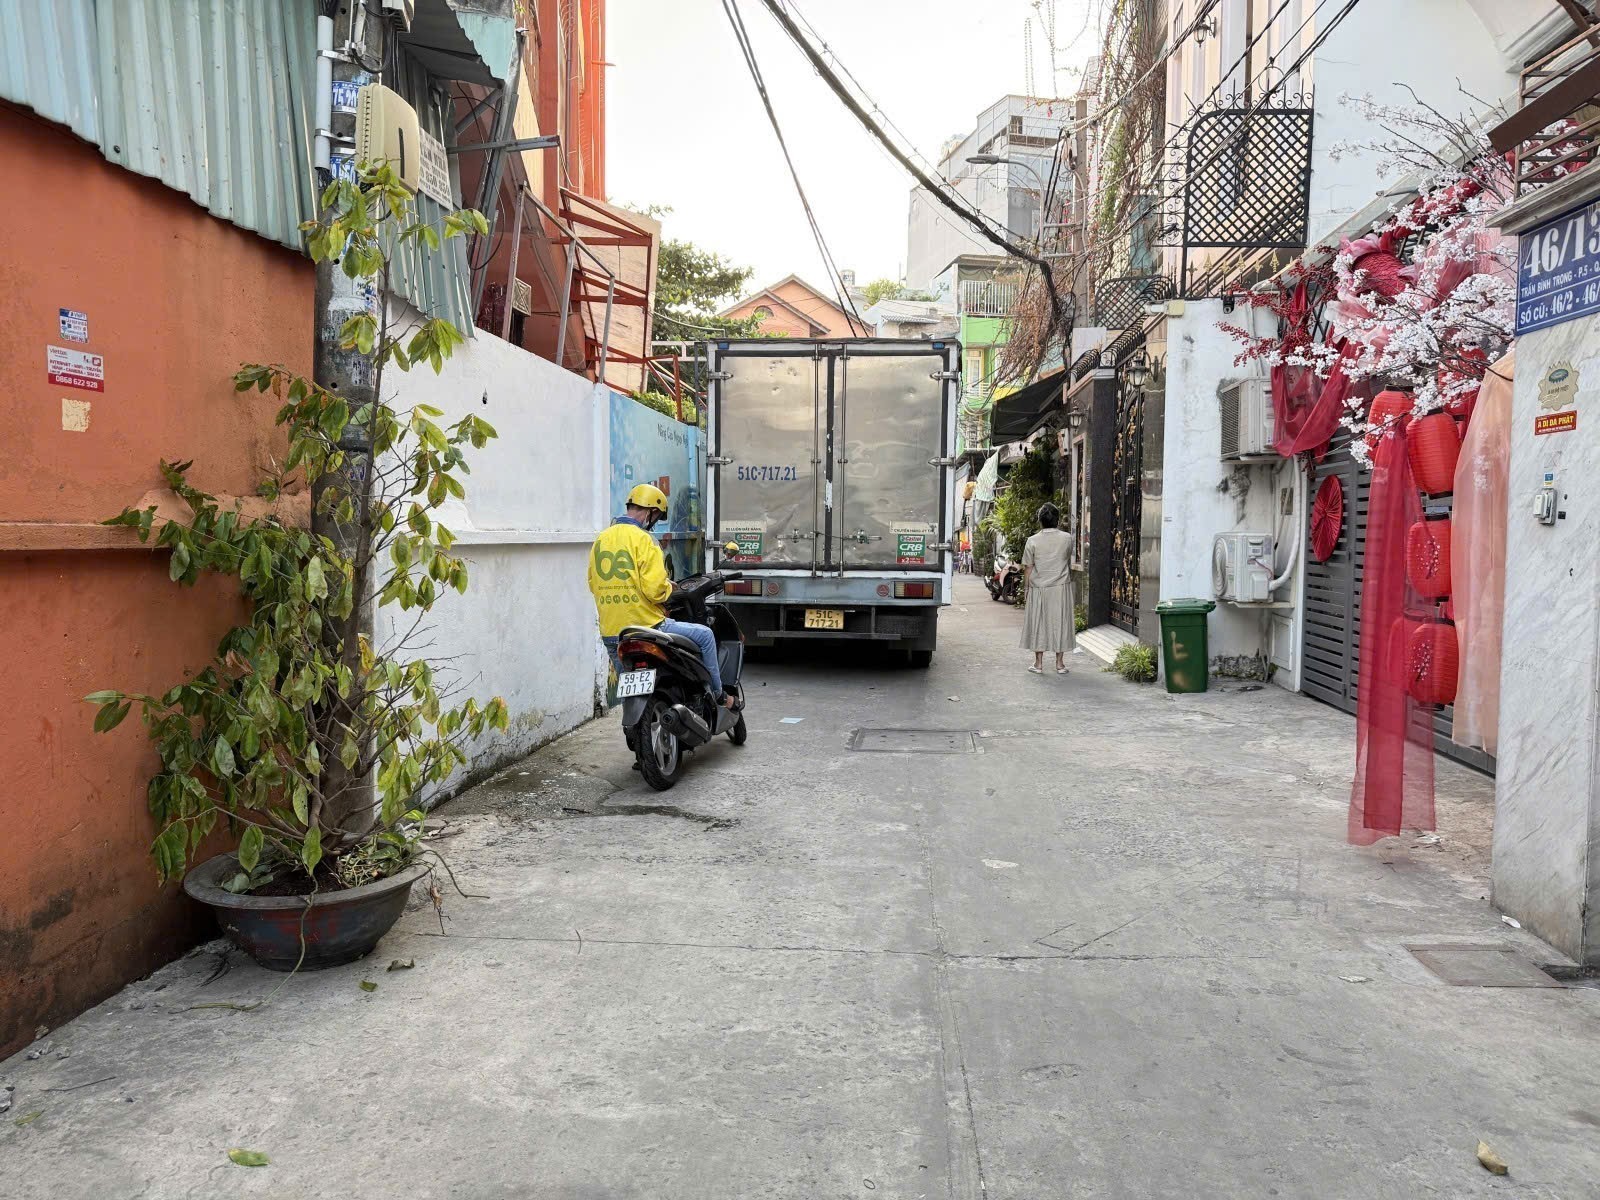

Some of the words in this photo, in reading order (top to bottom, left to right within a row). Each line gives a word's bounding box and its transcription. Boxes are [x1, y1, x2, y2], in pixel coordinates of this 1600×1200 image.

[1537, 278, 1551, 293] BÌNH
[1553, 271, 1573, 288] TRỌNG
[1578, 264, 1588, 278] P.5
[1520, 305, 1532, 325] SỐ
[1533, 302, 1548, 321] CŨ:
[1550, 290, 1573, 315] 46/2
[73, 378, 85, 387] 622
[899, 543, 923, 551] CRB
[594, 539, 636, 581] be
[816, 610, 833, 619] 51C
[809, 618, 839, 628] 717.21
[624, 671, 651, 685] 59-E2
[620, 682, 653, 696] 101.12
